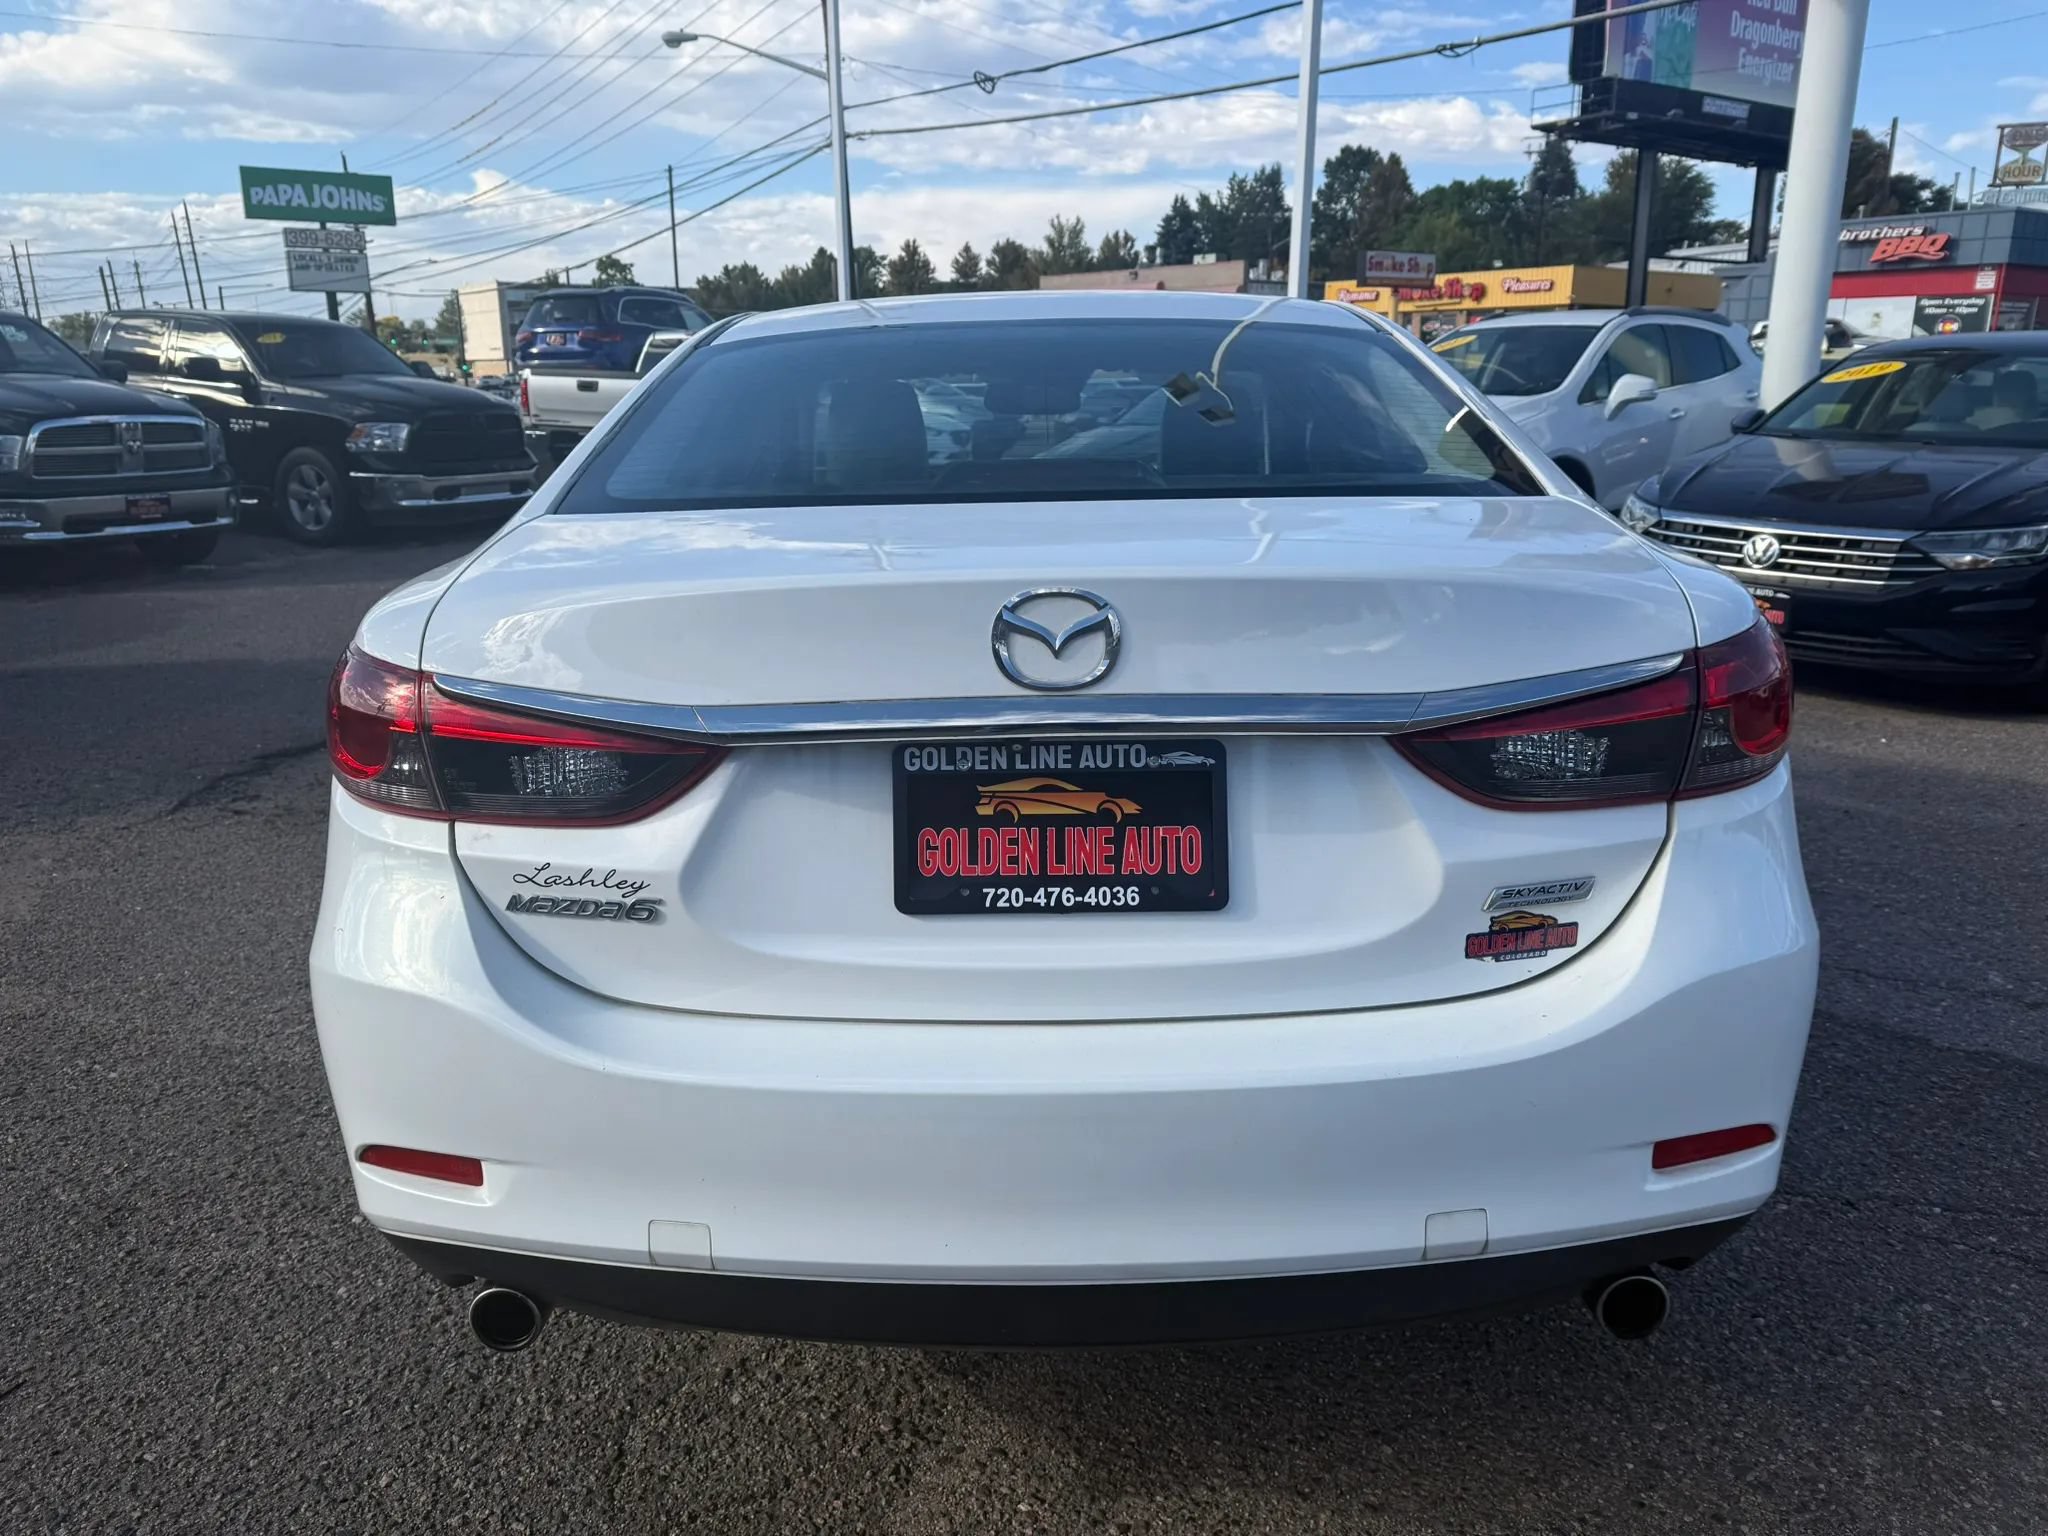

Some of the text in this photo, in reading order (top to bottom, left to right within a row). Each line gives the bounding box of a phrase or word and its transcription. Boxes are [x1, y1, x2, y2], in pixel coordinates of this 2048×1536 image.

[1737, 48, 1795, 86] Energizer
[2002, 165, 2042, 178] HOUR
[249, 183, 386, 212] PAPA JOHNS
[288, 229, 363, 249] 399-6262
[1870, 233, 1950, 263] BBQ
[1443, 277, 1485, 302] Shop
[1502, 277, 1553, 293] Pleasures
[1920, 297, 1986, 307] Open Everyday
[903, 743, 1147, 772] GOLDEN LINE AUTO
[917, 825, 1202, 877] GOLDEN LINE AUTO
[512, 862, 651, 899] Lashley
[1500, 881, 1587, 899] SKYACTIV
[982, 886, 1140, 908] 720-476-4036
[1506, 895, 1574, 908] TECHNOLOGY
[1468, 926, 1577, 956] GOLDEN LINE AUTO
[1500, 950, 1547, 961] COLORADO
